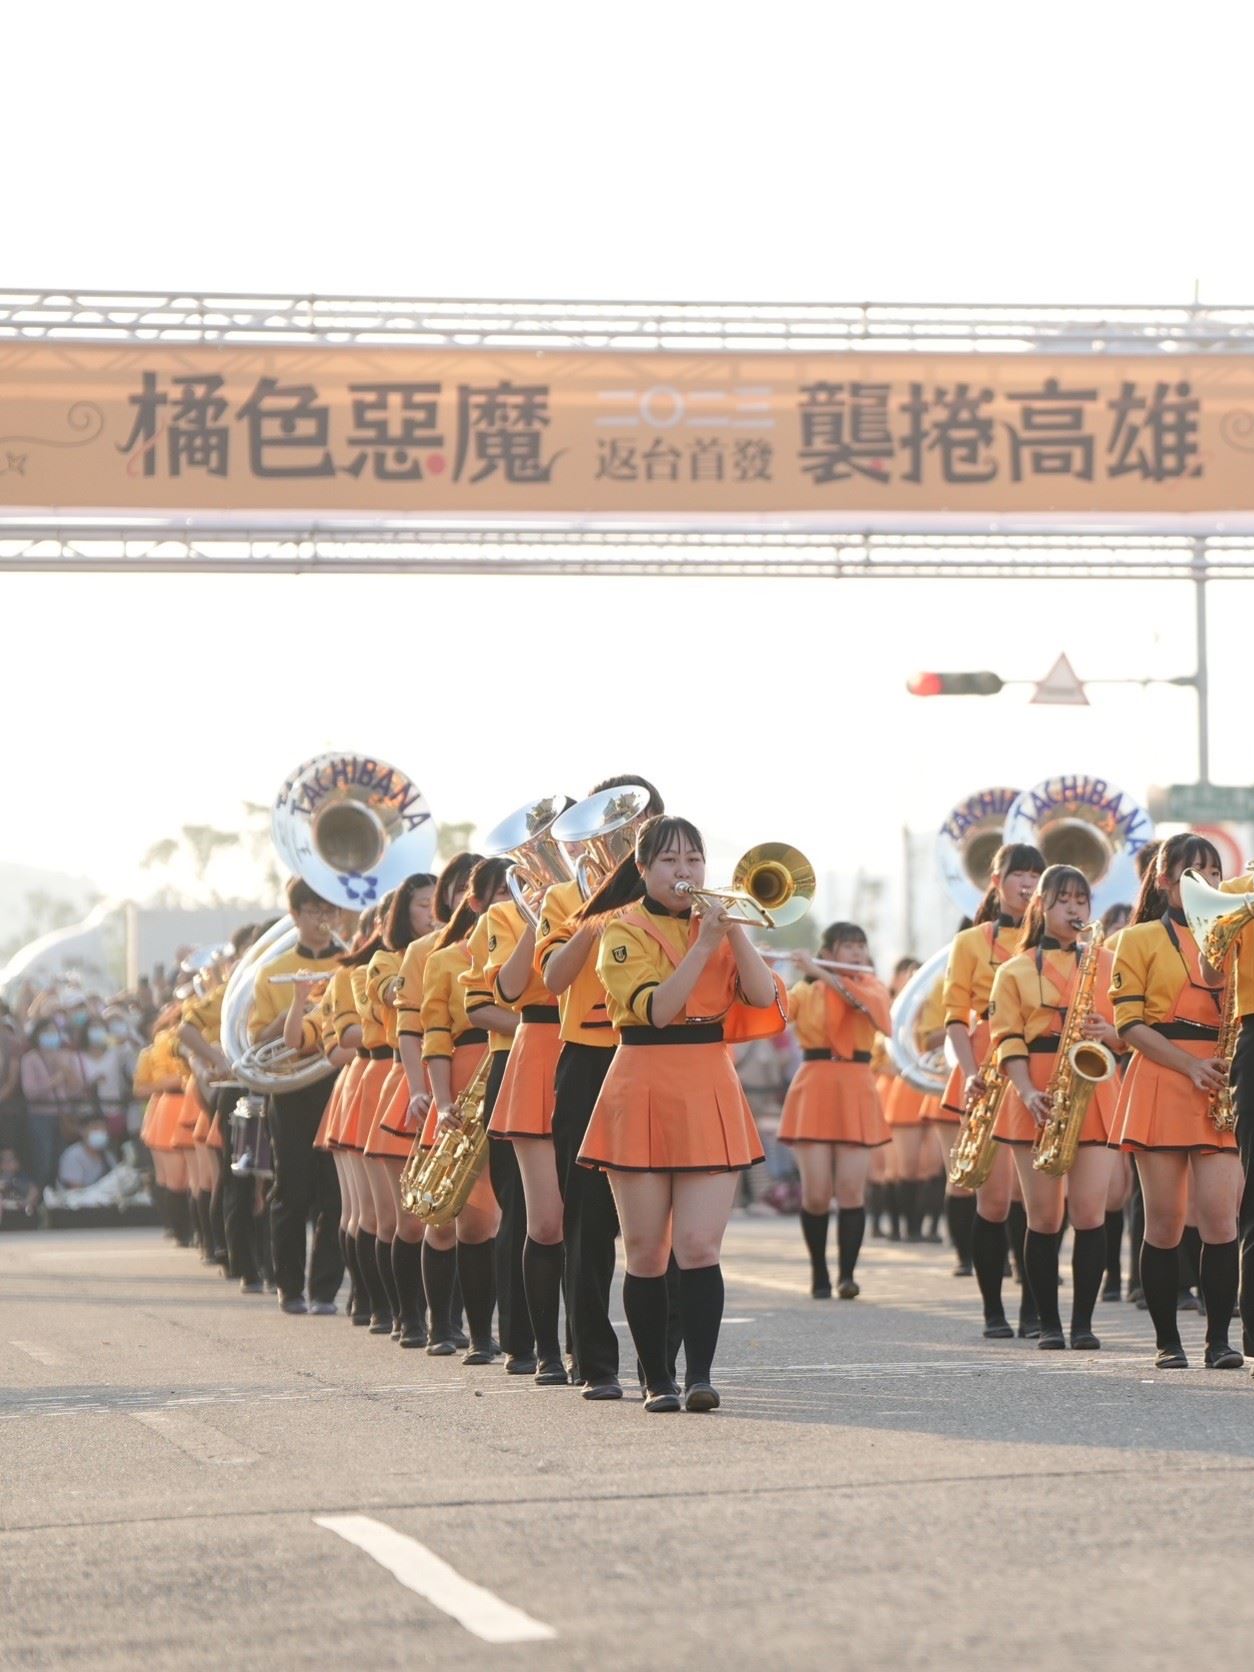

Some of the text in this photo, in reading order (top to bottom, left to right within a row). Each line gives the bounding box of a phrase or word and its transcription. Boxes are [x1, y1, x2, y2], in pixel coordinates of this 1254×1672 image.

[117, 370, 572, 486] 橘色惡魔
[594, 436, 774, 481] 返台首發
[797, 376, 1205, 486] 襲捲高雄
[290, 756, 431, 832] TACHIBANA
[1014, 774, 1149, 856] TACHIBANA
